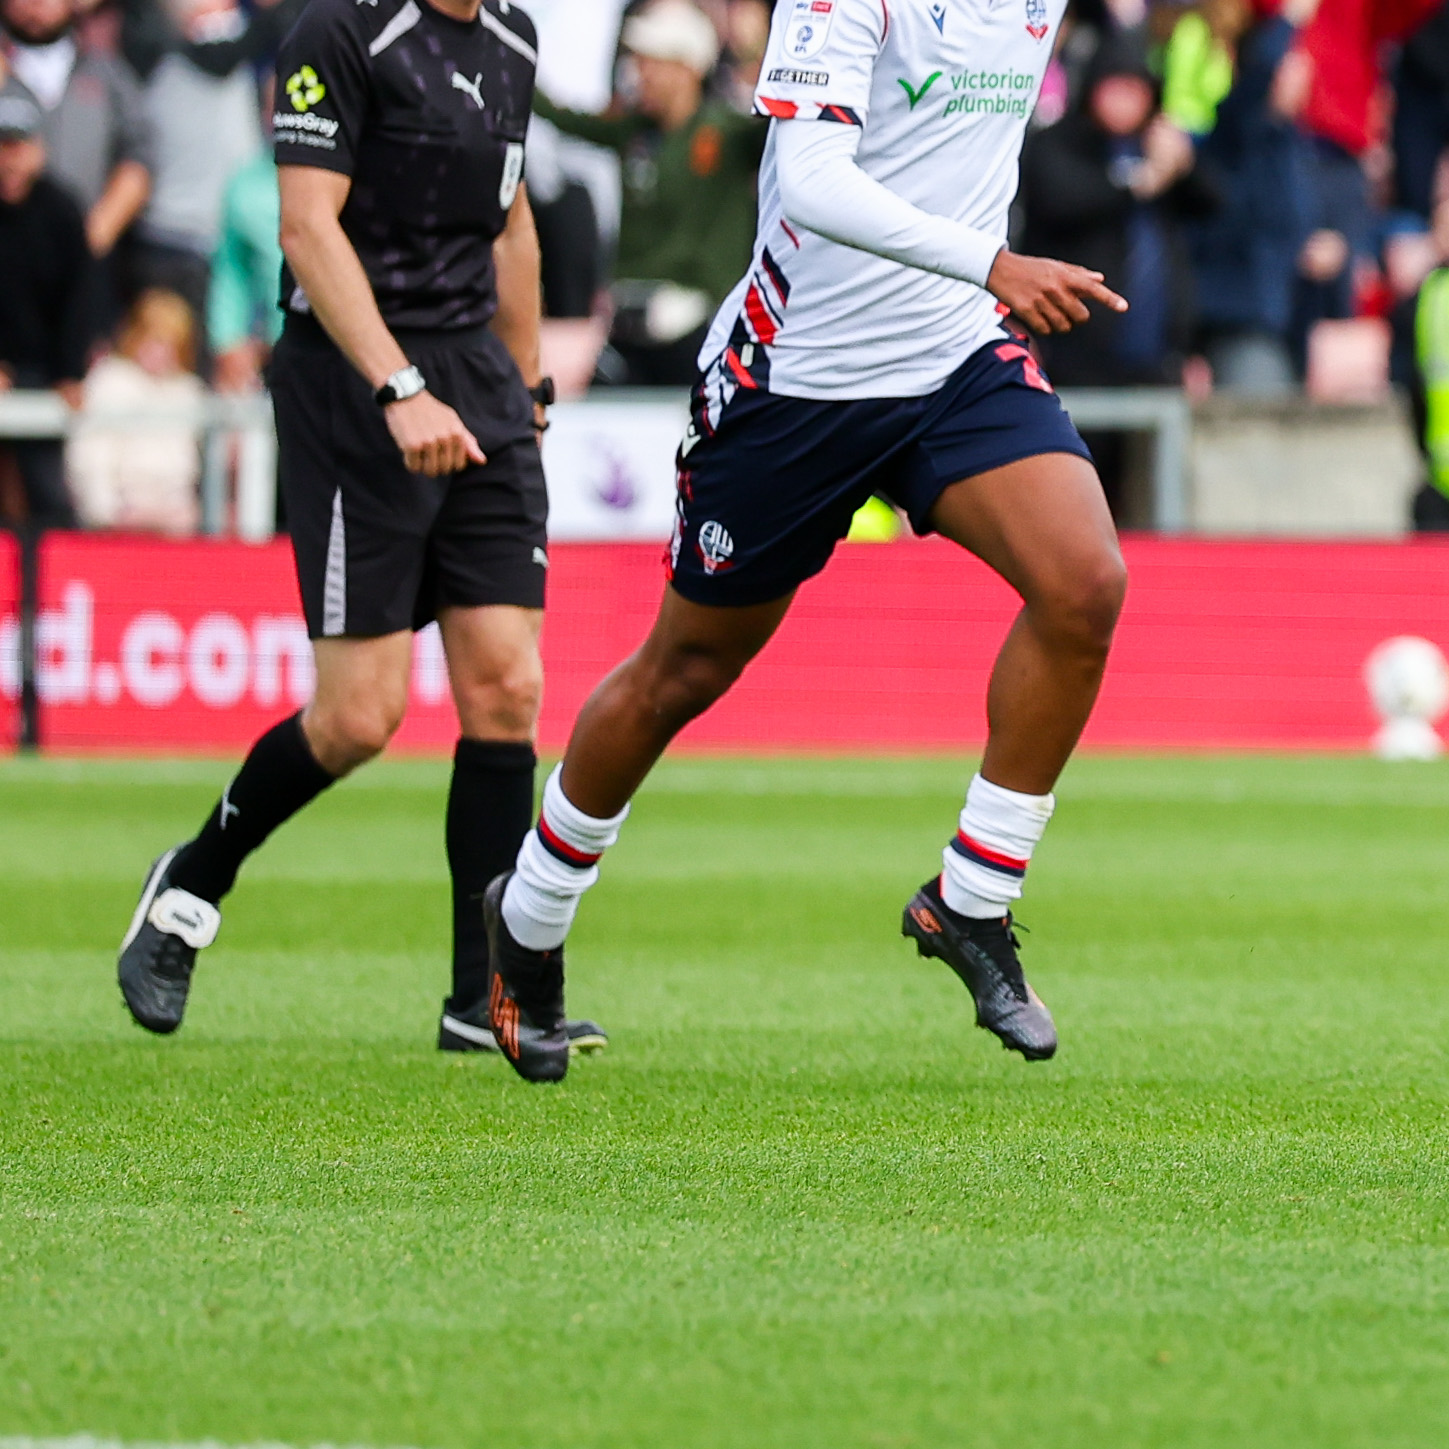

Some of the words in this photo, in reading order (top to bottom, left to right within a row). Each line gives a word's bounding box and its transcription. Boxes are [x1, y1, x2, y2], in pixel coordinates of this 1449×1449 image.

[951, 68, 1035, 90] victorian
[942, 93, 1028, 119] plumbing
[0, 579, 316, 706] d.com
